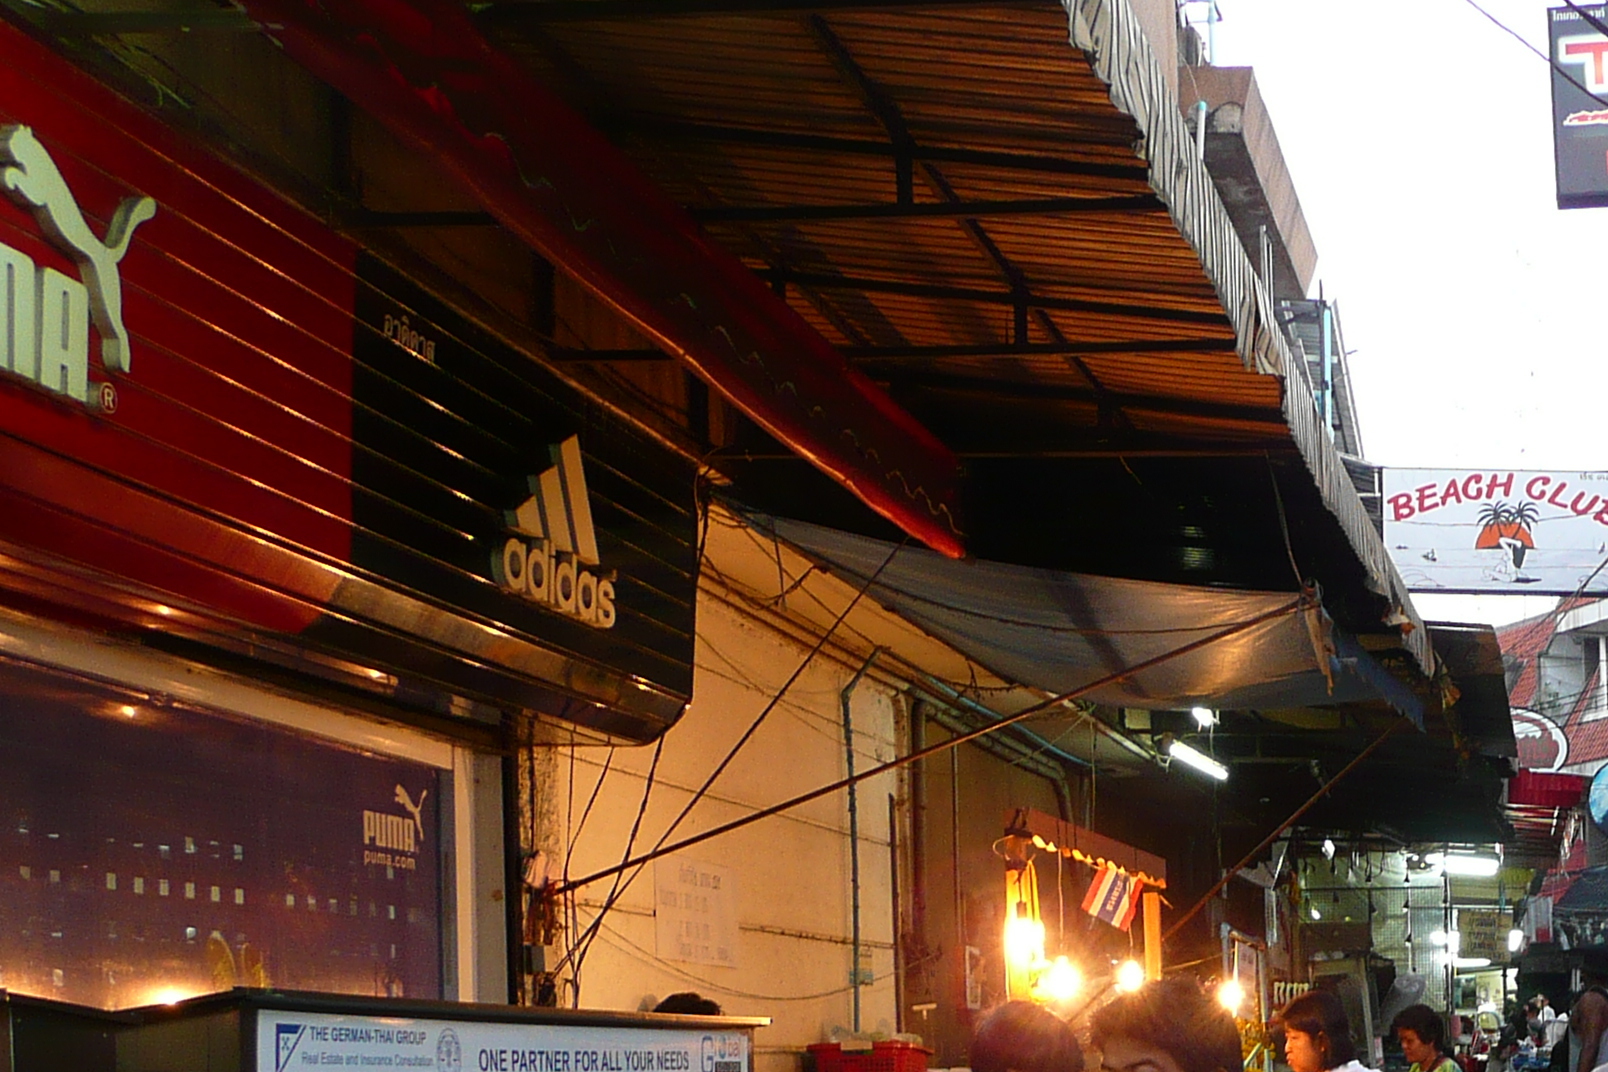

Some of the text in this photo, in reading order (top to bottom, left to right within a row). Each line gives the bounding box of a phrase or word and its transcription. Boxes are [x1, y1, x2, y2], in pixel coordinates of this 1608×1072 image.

[1386, 473, 1515, 522] BEACH
[503, 538, 616, 629] adidas
[363, 809, 415, 852] PUMA
[364, 850, 416, 869] puma.com
[309, 1026, 426, 1045] THE GERMAN-THAI GROUP
[479, 1049, 508, 1072] ONE
[511, 1050, 570, 1072] PARTNER
[575, 1051, 599, 1072] FOR
[600, 1051, 622, 1072] ALL
[624, 1050, 654, 1071] YOUR
[656, 1050, 690, 1071] NEEDS
